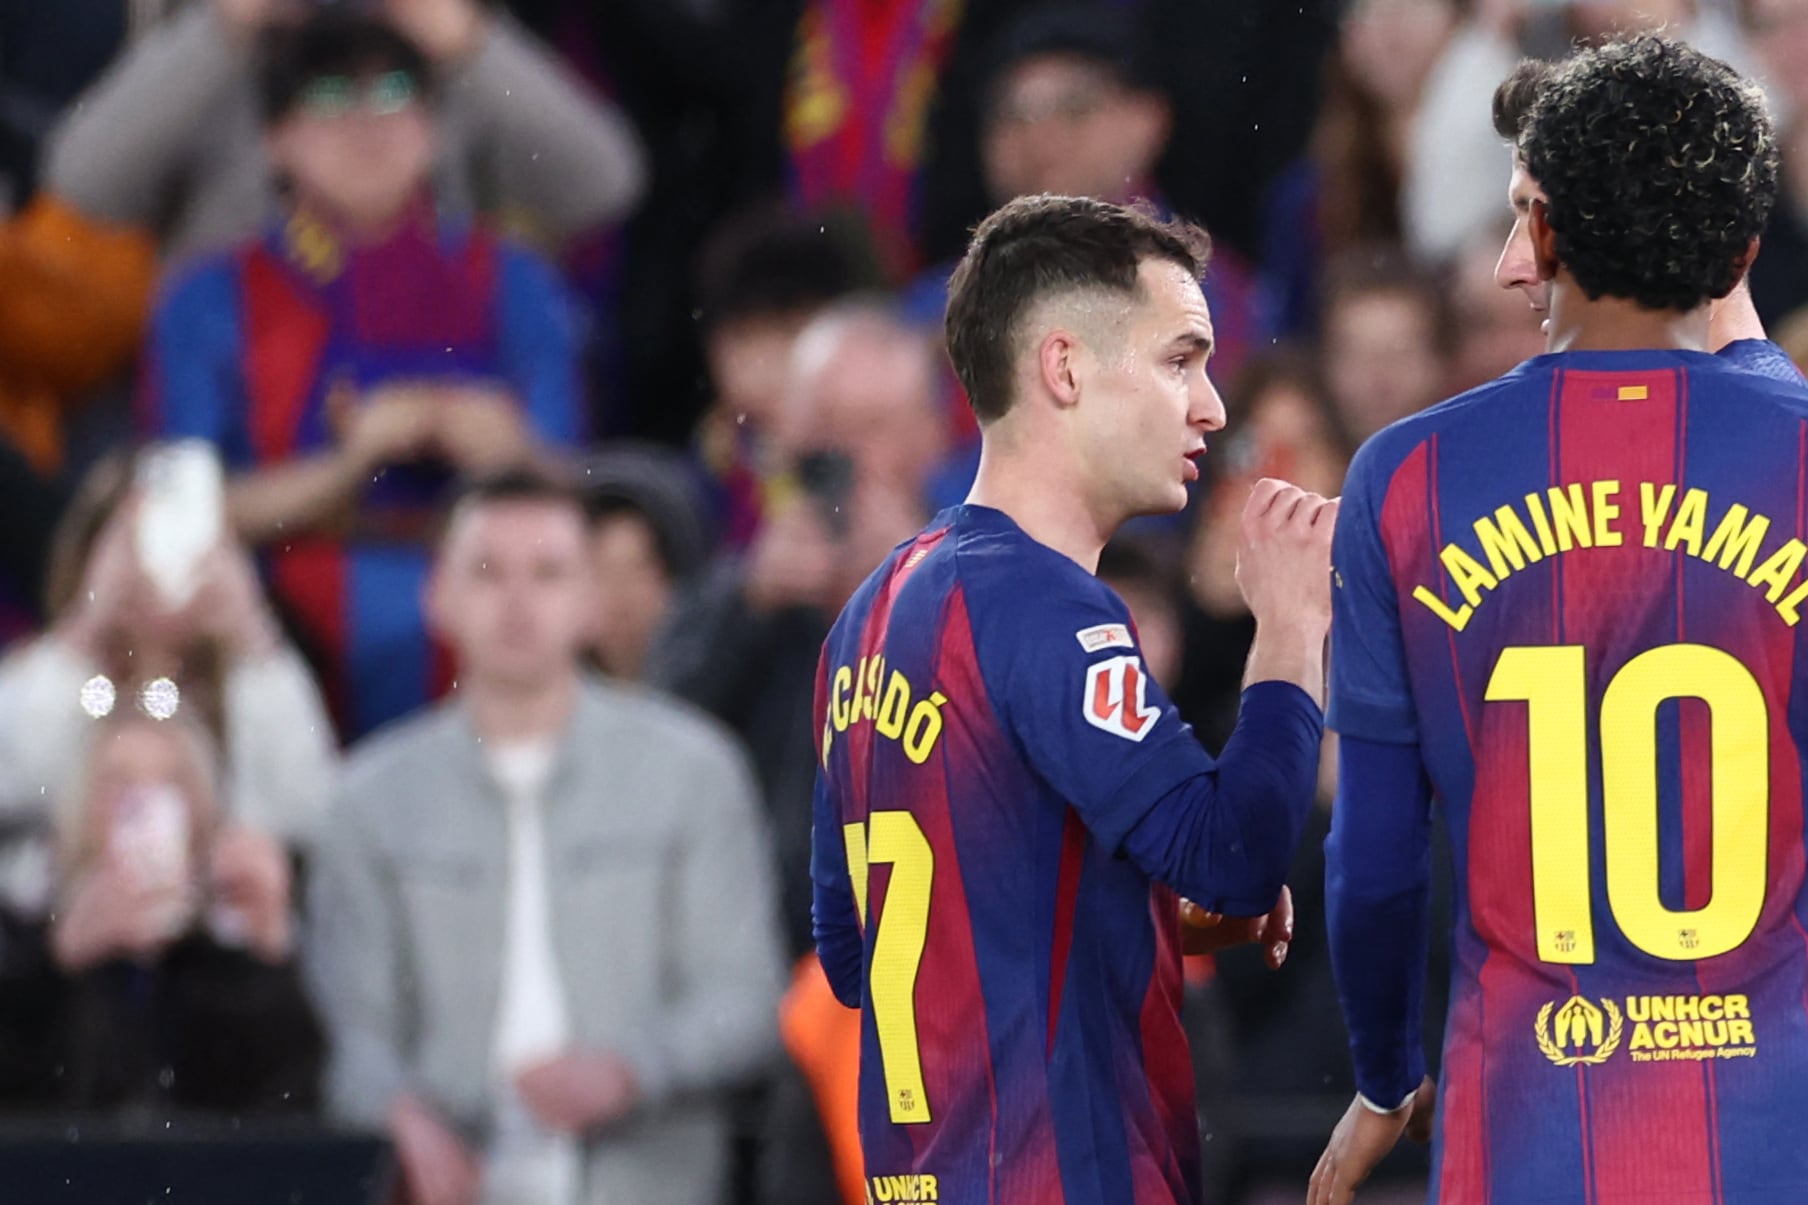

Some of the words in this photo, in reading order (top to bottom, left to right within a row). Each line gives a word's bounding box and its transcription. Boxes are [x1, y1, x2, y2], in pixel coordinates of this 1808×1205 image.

[1412, 479, 1624, 632] LAMINE
[1484, 643, 1770, 965] 10
[1626, 994, 1751, 1022] UNHCR
[1629, 1019, 1756, 1050] ACNUR
